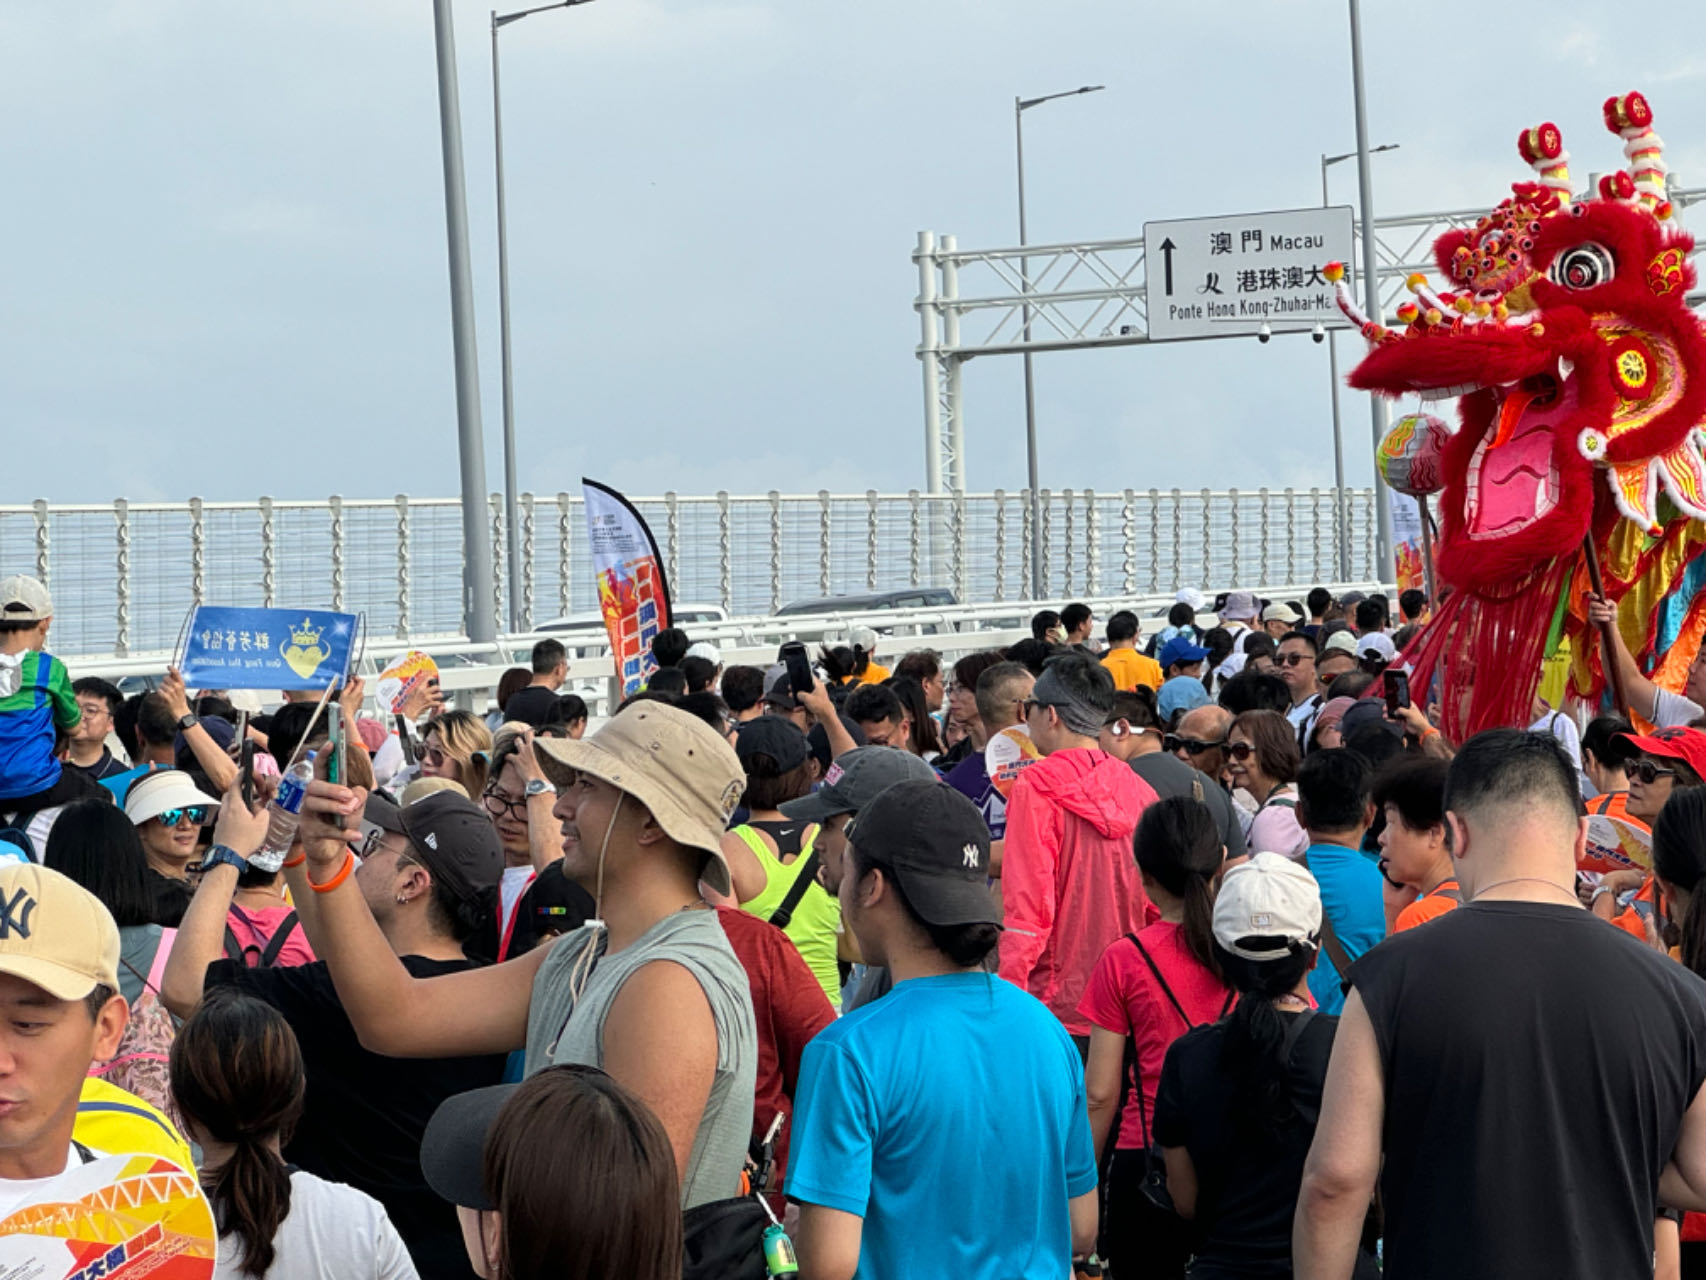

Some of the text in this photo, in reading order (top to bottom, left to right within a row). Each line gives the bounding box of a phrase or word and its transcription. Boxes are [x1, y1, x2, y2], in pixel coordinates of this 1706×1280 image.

[1210, 230, 1262, 255] 澳門
[1270, 235, 1323, 251] Macau
[1169, 303, 1203, 320] Ponte
[1207, 301, 1235, 317] Hong
[963, 843, 979, 868] NY
